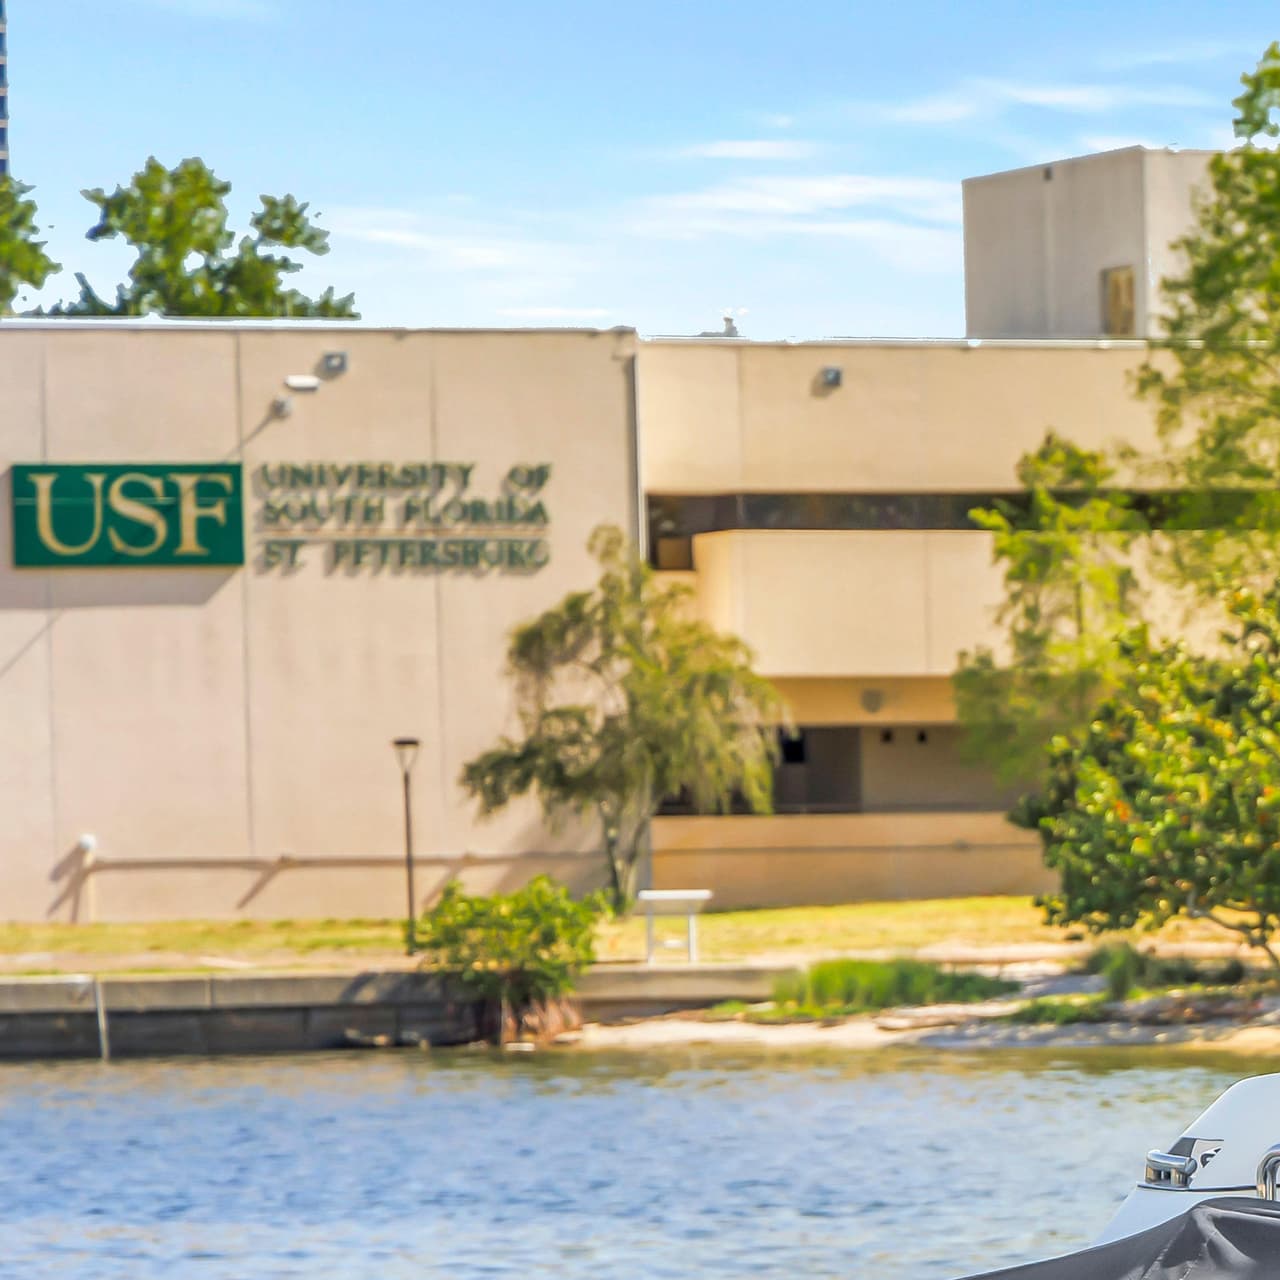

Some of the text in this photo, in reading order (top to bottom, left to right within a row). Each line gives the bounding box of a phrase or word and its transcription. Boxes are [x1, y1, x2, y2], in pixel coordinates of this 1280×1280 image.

[260, 463, 553, 489] UNIVERSITY OF
[27, 472, 234, 556] USF
[262, 496, 549, 524] SOUTH FLORIDA
[335, 539, 551, 568] PETERSBURG
